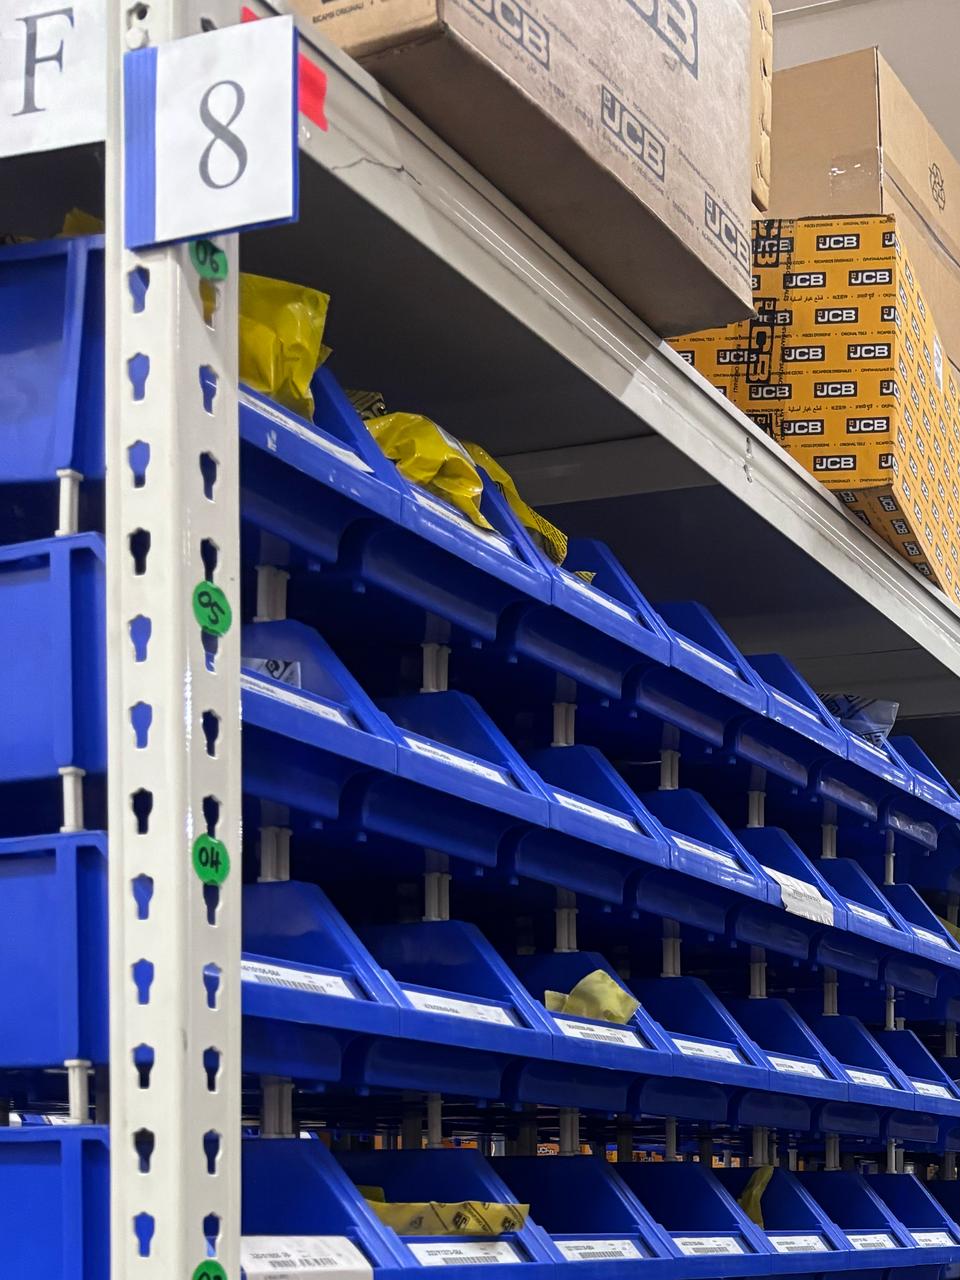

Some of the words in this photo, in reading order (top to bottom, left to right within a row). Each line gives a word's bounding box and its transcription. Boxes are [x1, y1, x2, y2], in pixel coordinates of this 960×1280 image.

[11, 7, 76, 118] F
[199, 79, 249, 190] 8
[602, 88, 665, 180] JCB
[706, 193, 750, 274] JCB
[818, 236, 857, 249] JCB
[786, 274, 824, 287] JCB
[851, 271, 890, 284] JCB
[817, 309, 856, 322] JCB
[784, 348, 823, 360] JCB
[849, 345, 889, 358] JCB
[751, 386, 790, 398] JCB
[816, 384, 855, 396] JCB
[784, 421, 822, 434] JCB
[848, 419, 888, 432] JCB
[815, 457, 855, 469] JCB
[196, 590, 226, 624] 05
[197, 846, 222, 872] 04
